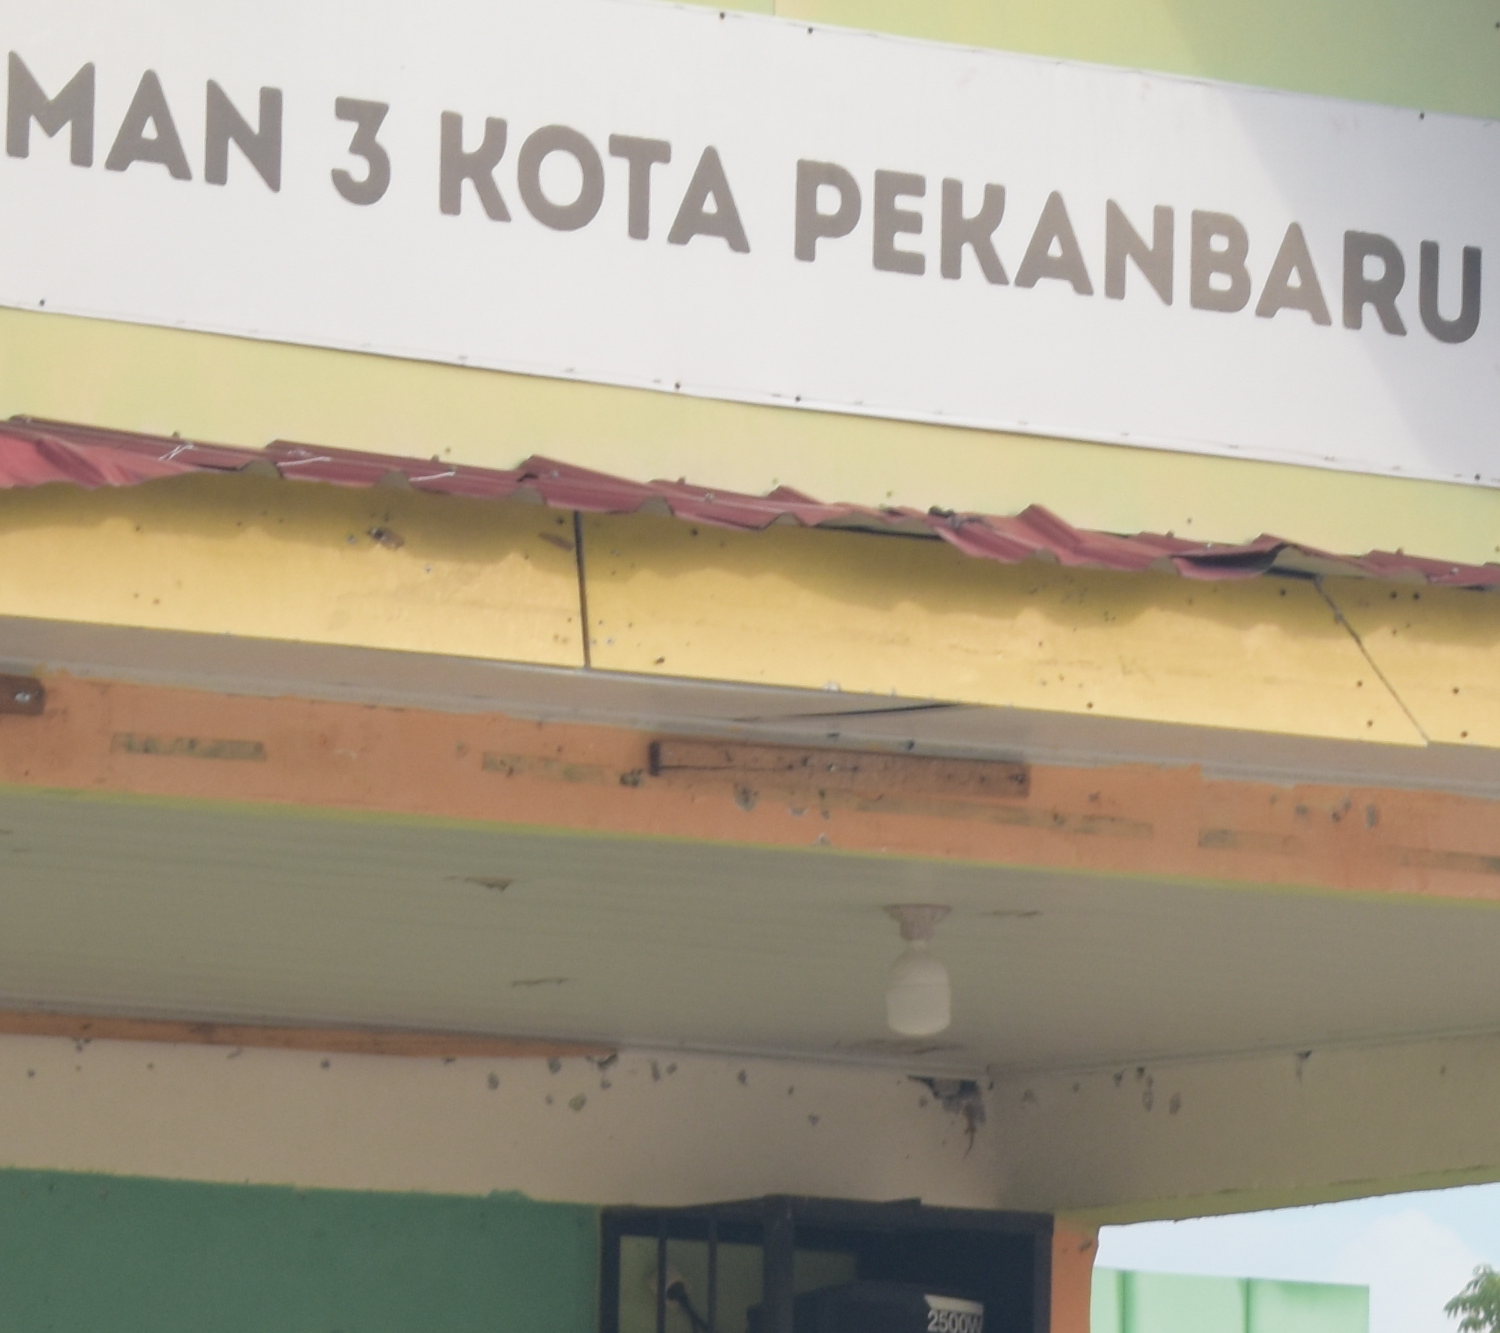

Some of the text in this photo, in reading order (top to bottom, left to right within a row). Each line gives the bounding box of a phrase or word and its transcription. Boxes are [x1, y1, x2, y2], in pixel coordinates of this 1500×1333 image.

[6, 50, 1483, 345] MAN 3 KOTA PEKANBARU
